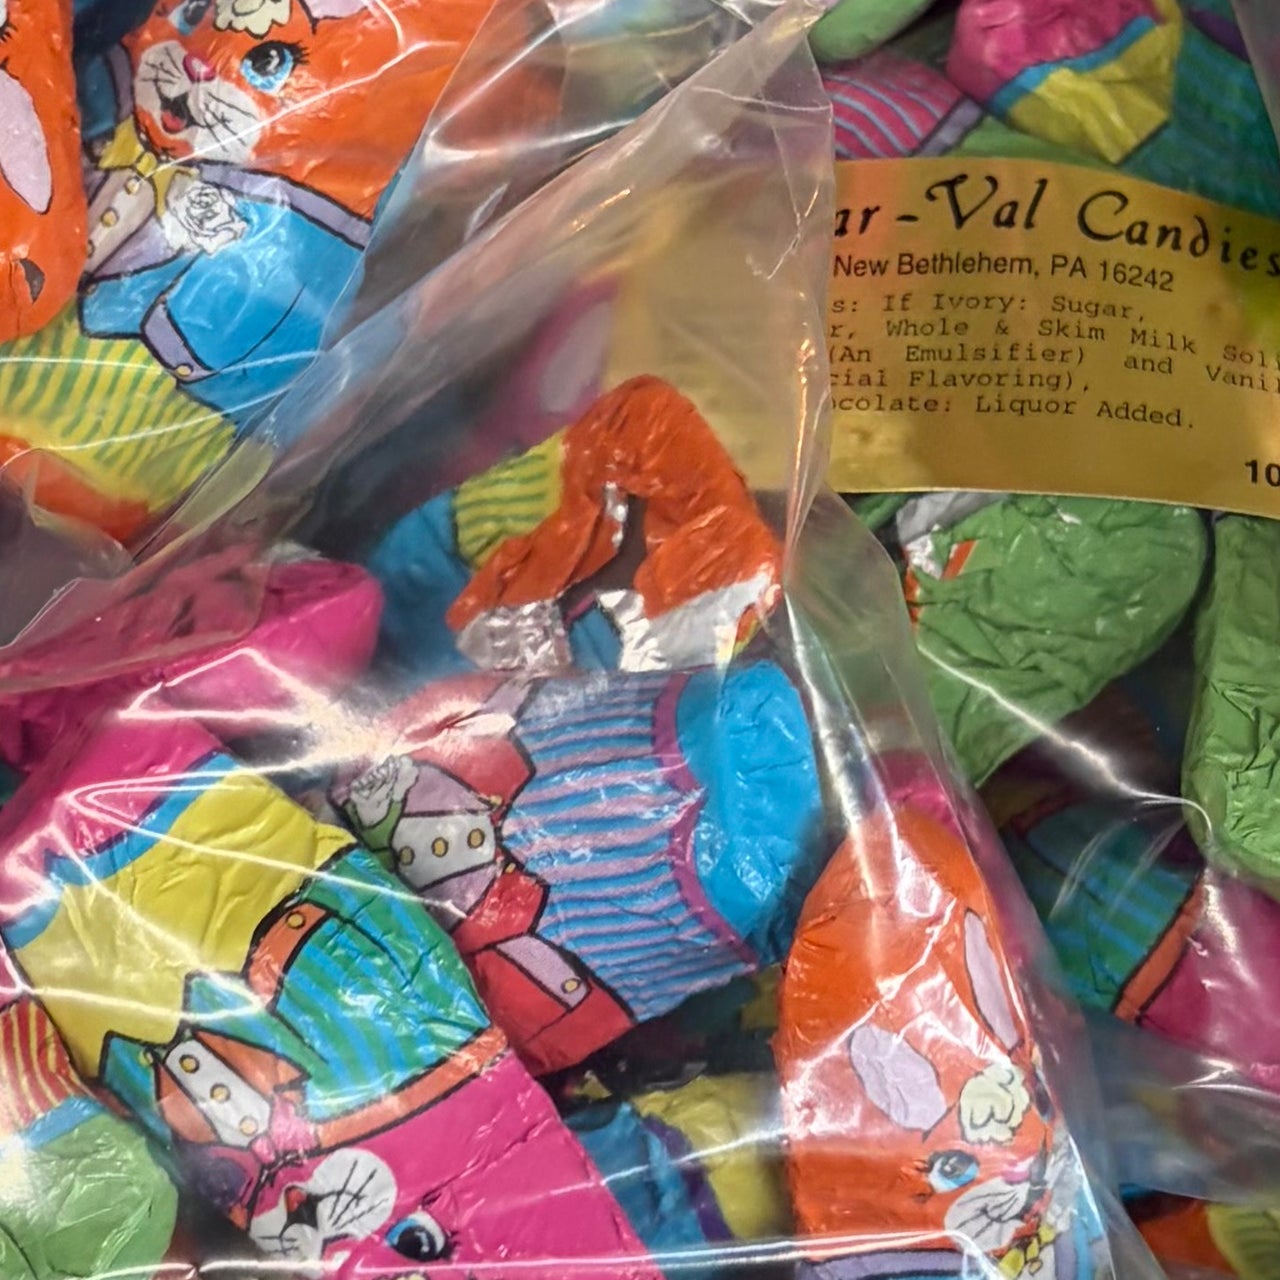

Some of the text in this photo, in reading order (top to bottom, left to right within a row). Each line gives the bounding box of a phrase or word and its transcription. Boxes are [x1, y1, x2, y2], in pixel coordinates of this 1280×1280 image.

[833, 172, 1280, 277] ar-Val Candies
[832, 250, 1174, 293] New Bethlehem, PA 16242
[882, 291, 913, 312] If
[932, 292, 1026, 314] Ivory:
[1050, 294, 1144, 323] Sugar,
[885, 316, 969, 337] Whole
[994, 318, 1009, 335] &
[1037, 317, 1105, 341] Skim
[1129, 326, 1196, 354] Milk
[828, 344, 871, 365] (An
[904, 341, 1084, 365] Emulsifier)
[1123, 355, 1173, 374] and
[908, 367, 1089, 393] Flavoring),
[831, 392, 1193, 428] colate: Liquor Added.
